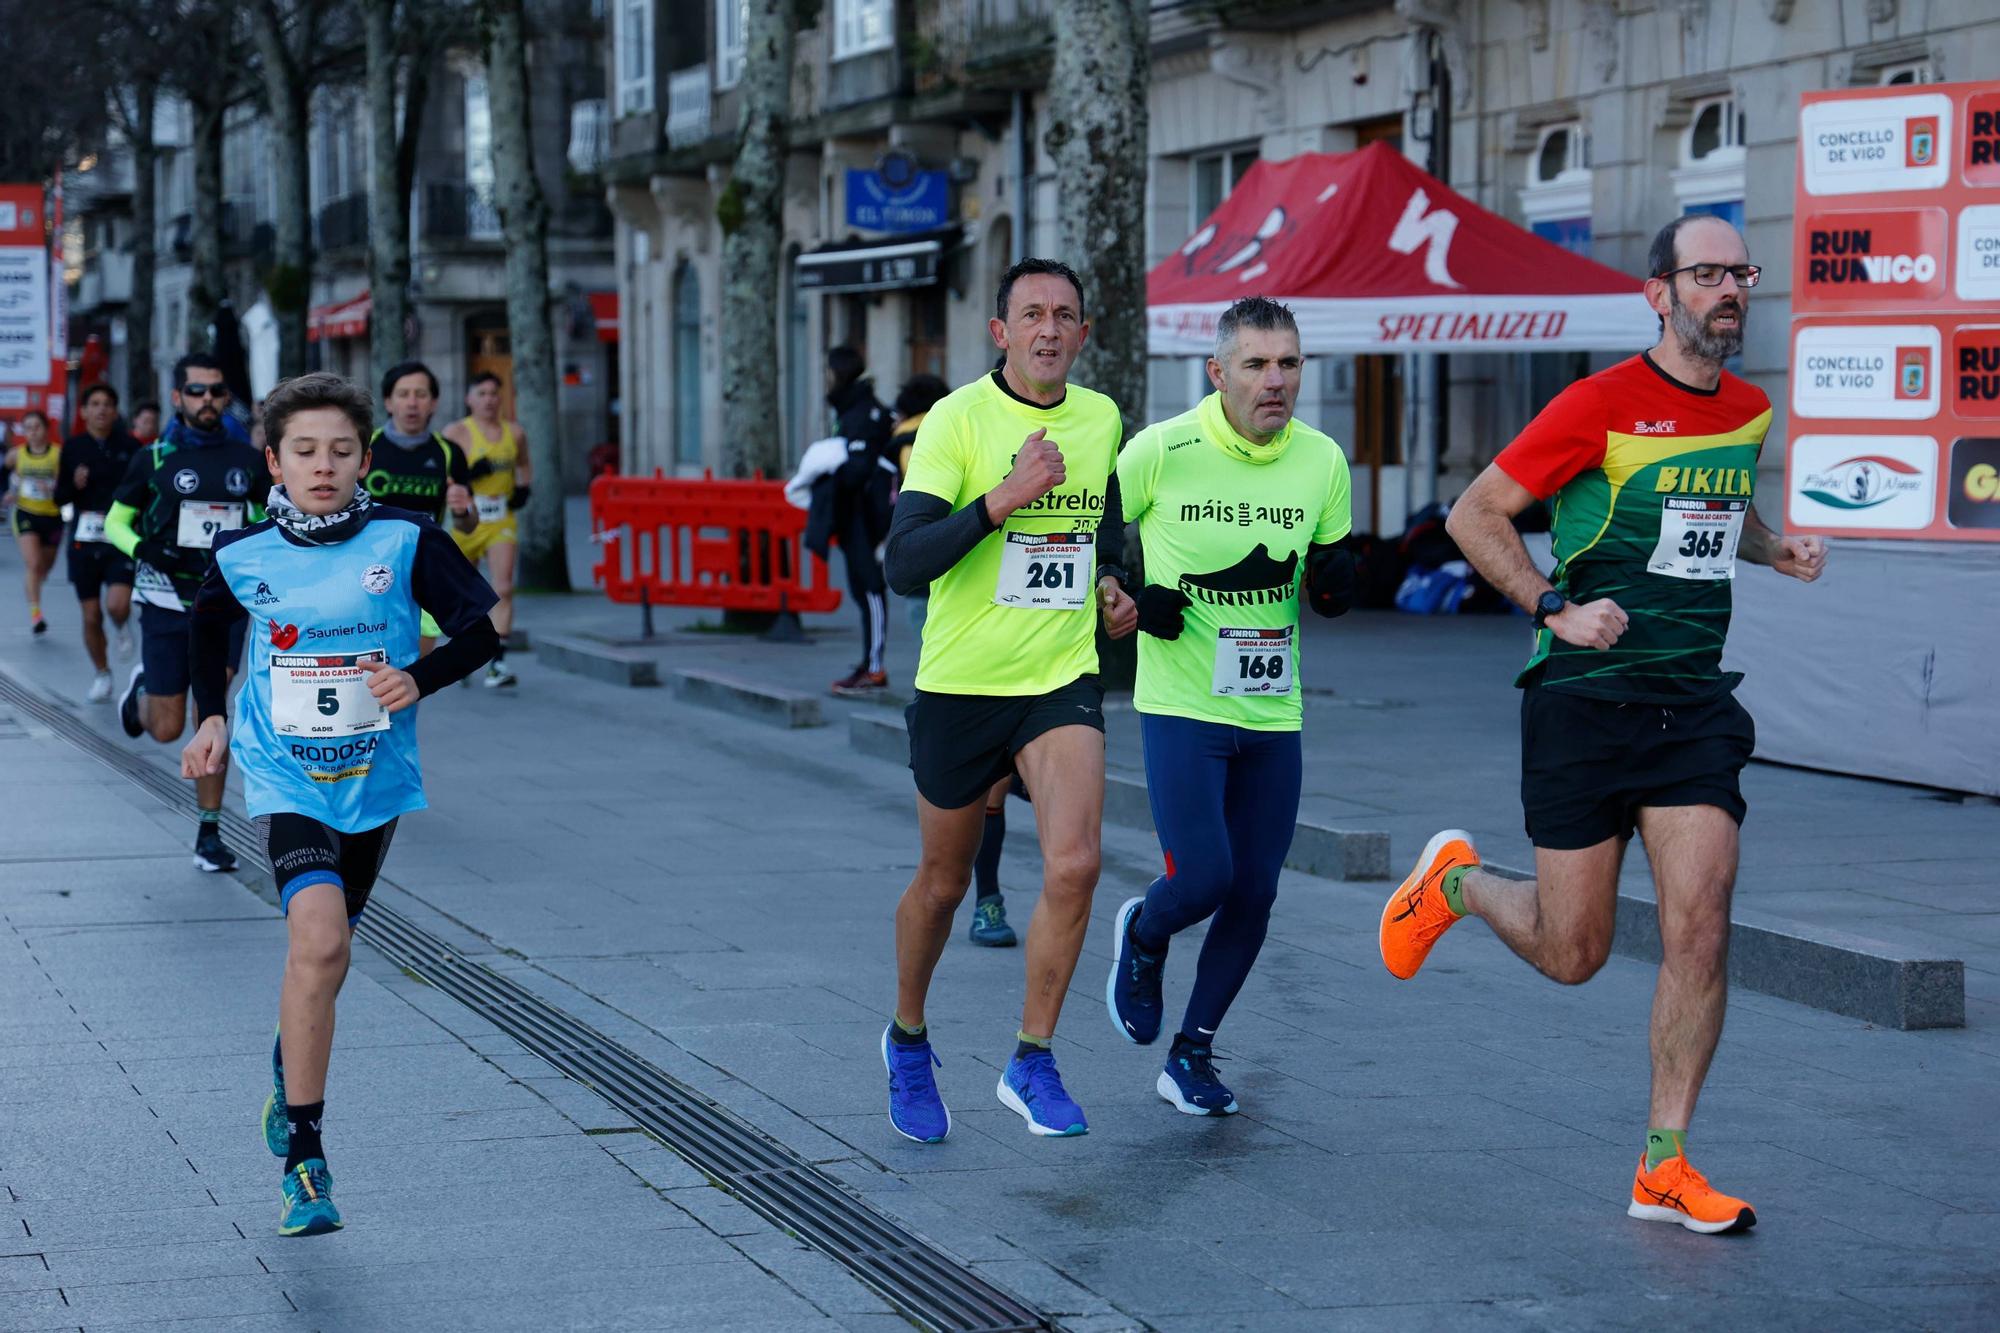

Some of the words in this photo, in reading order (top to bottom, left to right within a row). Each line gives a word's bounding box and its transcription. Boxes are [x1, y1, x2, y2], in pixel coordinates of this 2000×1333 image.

[1818, 129, 1895, 148] CONCELLO
[1828, 150, 1847, 163] DE
[1852, 147, 1886, 161] VIGO
[1811, 229, 1872, 254] RUN
[1377, 310, 1568, 341] SPECIALIZED
[1807, 356, 1884, 370] CONCELLO
[1815, 374, 1832, 388] DE
[1841, 373, 1874, 388] VIGO
[1168, 439, 1193, 452] luanvi
[1655, 466, 1752, 496] BIKILA
[1180, 499, 1234, 523] máis
[1238, 502, 1252, 527] que
[1256, 507, 1304, 529] auga
[1679, 530, 1726, 558] 365
[1026, 562, 1075, 589] 261
[1178, 580, 1295, 607] RUNNING
[306, 625, 355, 639] Saunier
[357, 619, 388, 634] Duval
[332, 668, 364, 676] CASTRO
[1239, 655, 1284, 680] 168
[317, 687, 340, 716] 5
[291, 736, 378, 763] RODOSA
